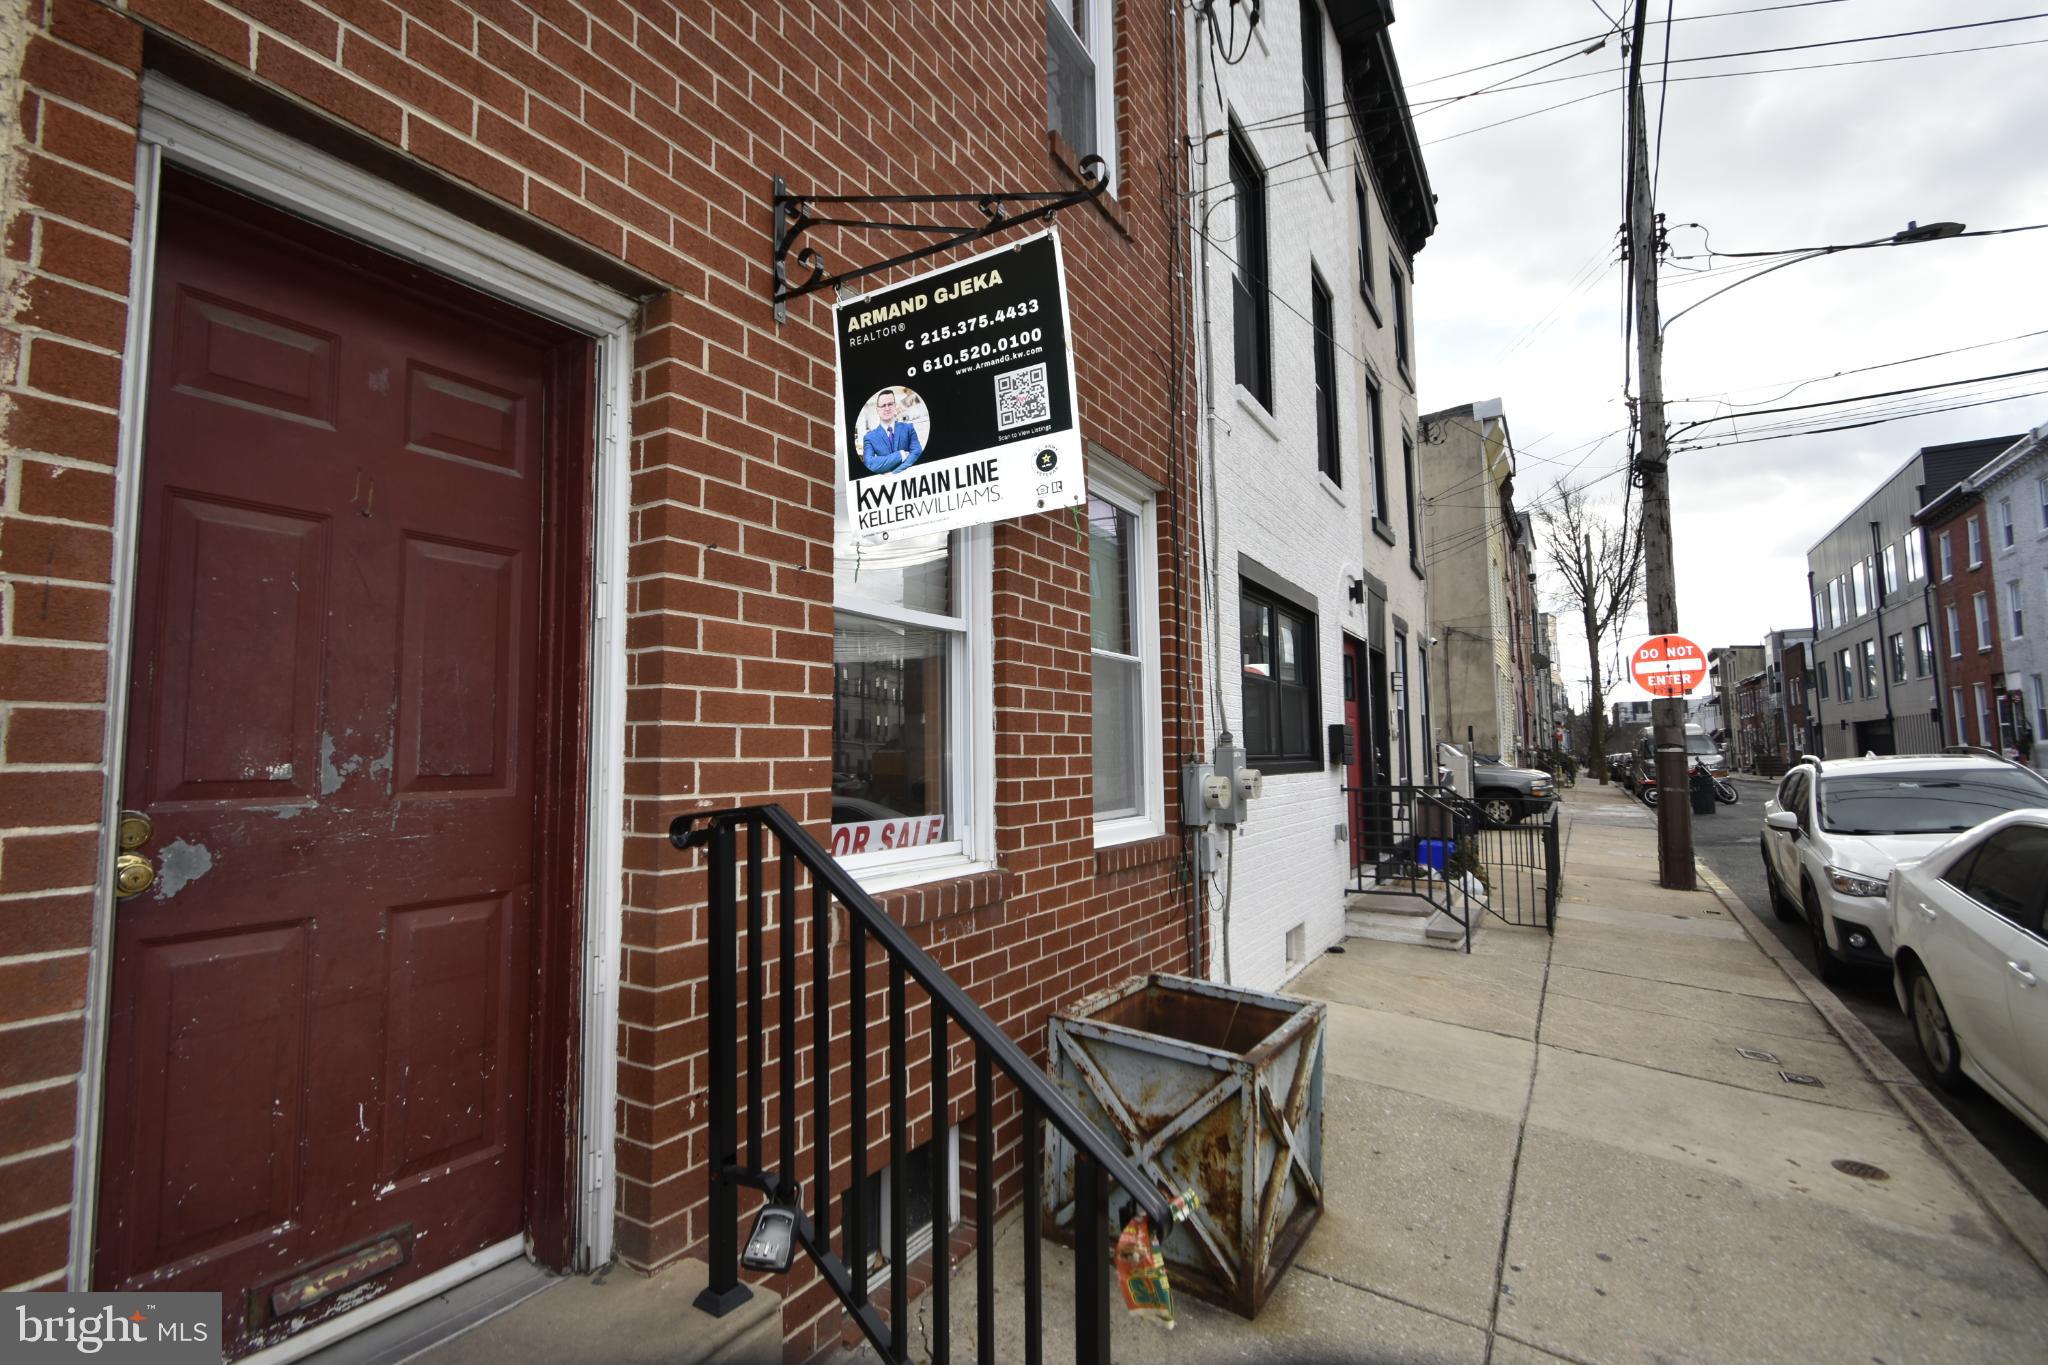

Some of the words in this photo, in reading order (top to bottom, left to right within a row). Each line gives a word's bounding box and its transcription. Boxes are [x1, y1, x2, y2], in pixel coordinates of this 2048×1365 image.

[848, 294, 928, 333] ARMAND
[934, 269, 1003, 304] GJEKA
[920, 299, 1039, 346] 215.375.4433
[922, 328, 1042, 373] 610.520.0100
[955, 346, 1043, 375] www.ArmandG.kw.com
[998, 432, 1011, 441] Scan
[1018, 429, 1031, 437] View
[1031, 424, 1052, 434] Listings
[901, 469, 951, 501] MAIN
[955, 458, 999, 489] LINE
[1640, 648, 1659, 659] DO
[1666, 646, 1693, 657] NOT
[1648, 674, 1692, 686] ENTER
[831, 825, 870, 857] OR
